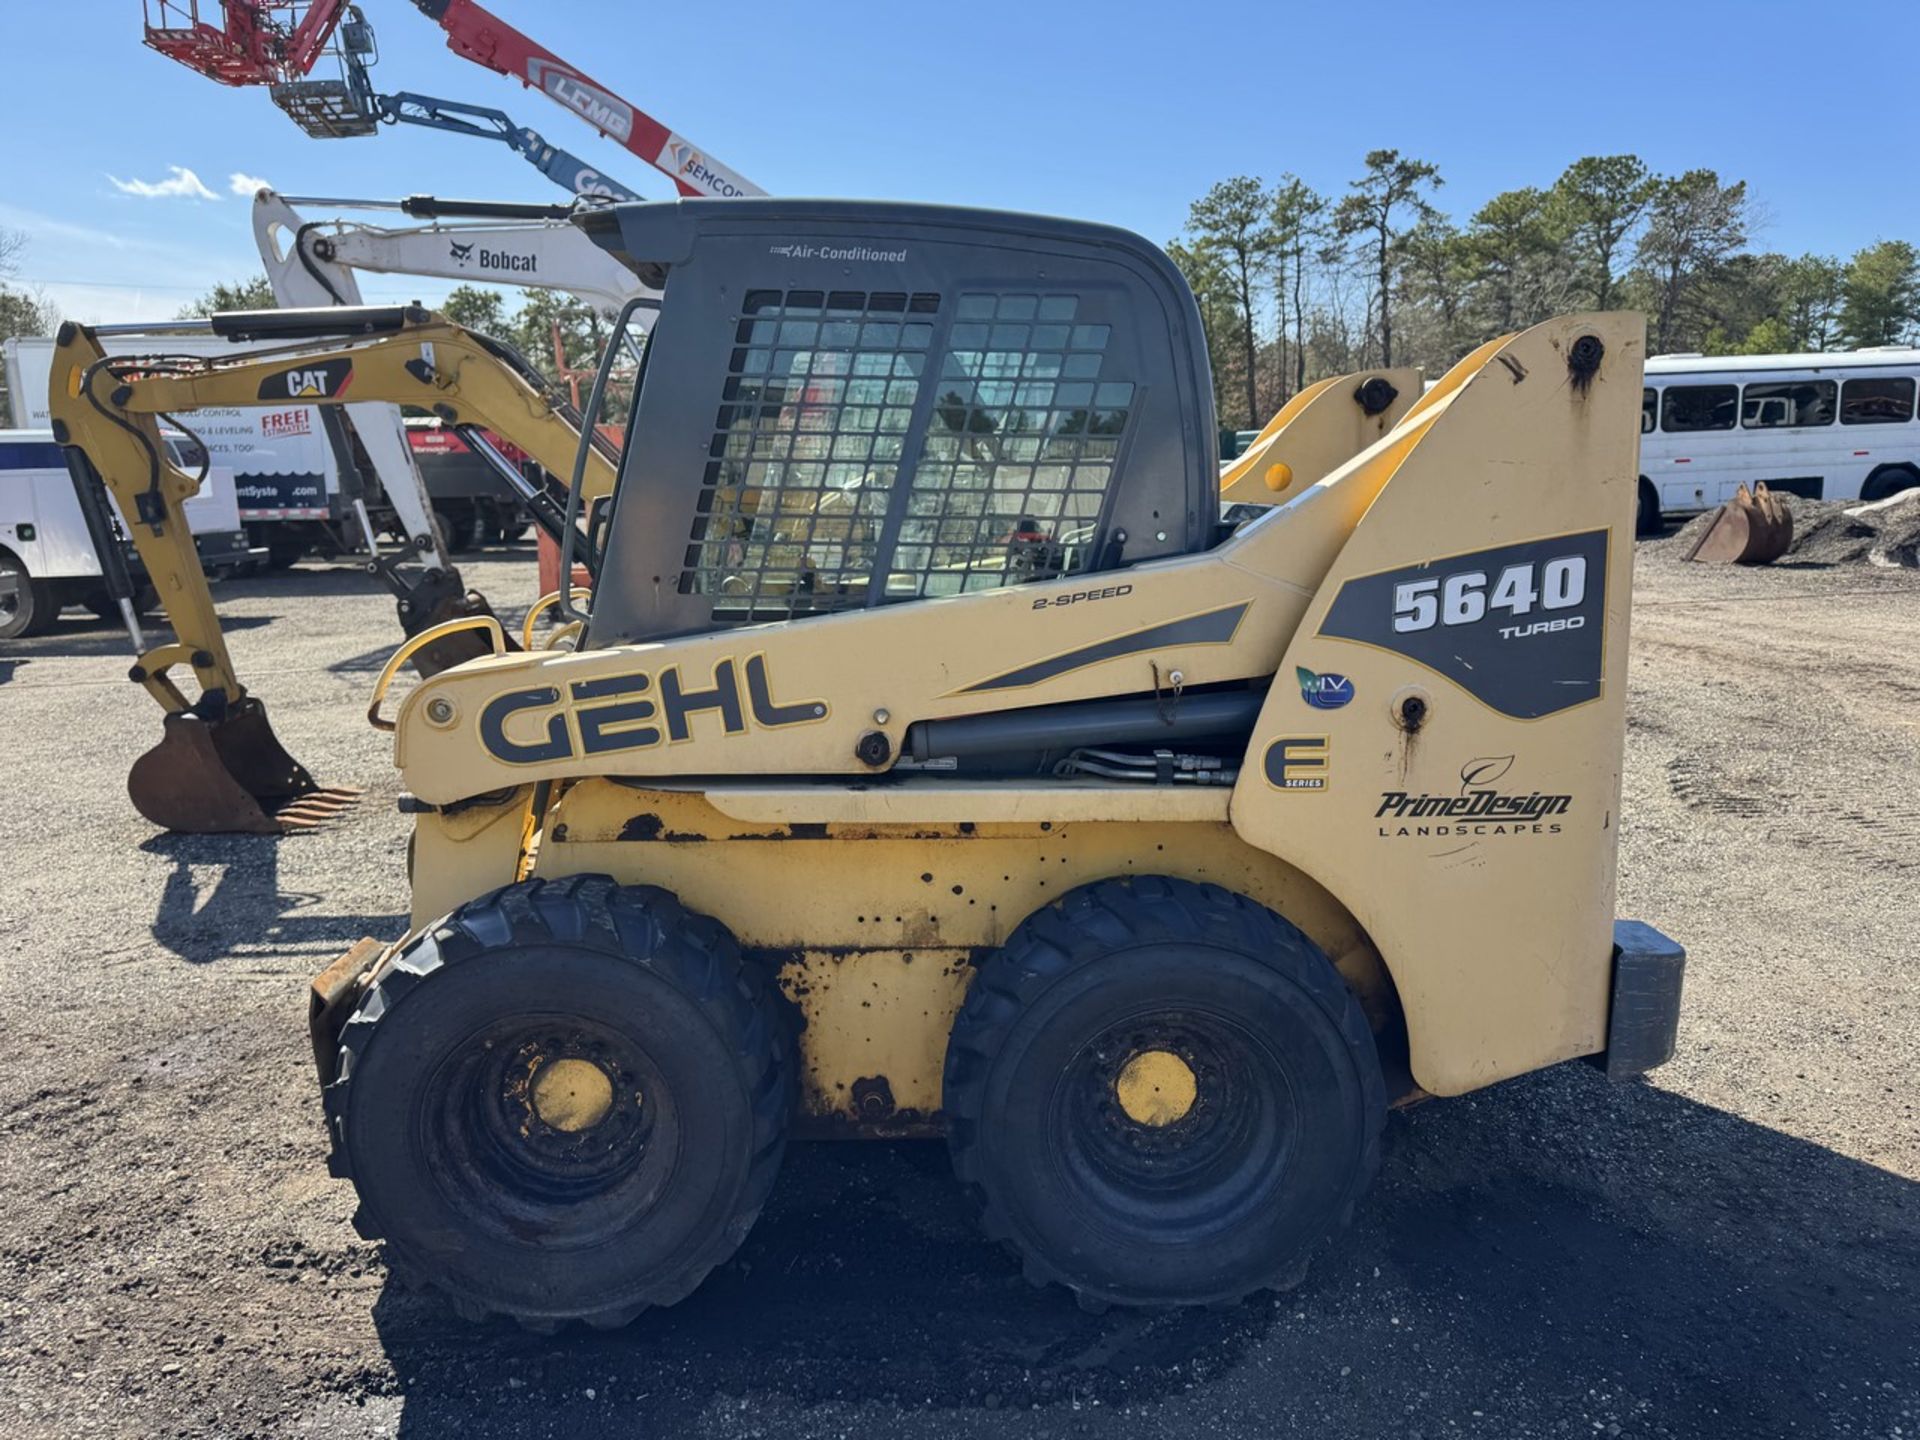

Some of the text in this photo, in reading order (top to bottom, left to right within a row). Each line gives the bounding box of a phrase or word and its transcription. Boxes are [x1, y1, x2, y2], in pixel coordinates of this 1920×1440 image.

[479, 249, 537, 272] Bobcat
[792, 244, 907, 262] Air-Conditioned
[287, 370, 328, 397] CAT
[262, 409, 309, 428] FREE!
[215, 427, 254, 435] LEVELING
[1032, 584, 1133, 610] 2-SPEED
[1393, 555, 1586, 633] 5640
[1499, 616, 1585, 639] TURBO
[476, 651, 832, 766] GEHL
[1285, 779, 1321, 787] SERIES
[1379, 824, 1562, 837] LANDSCAPES
